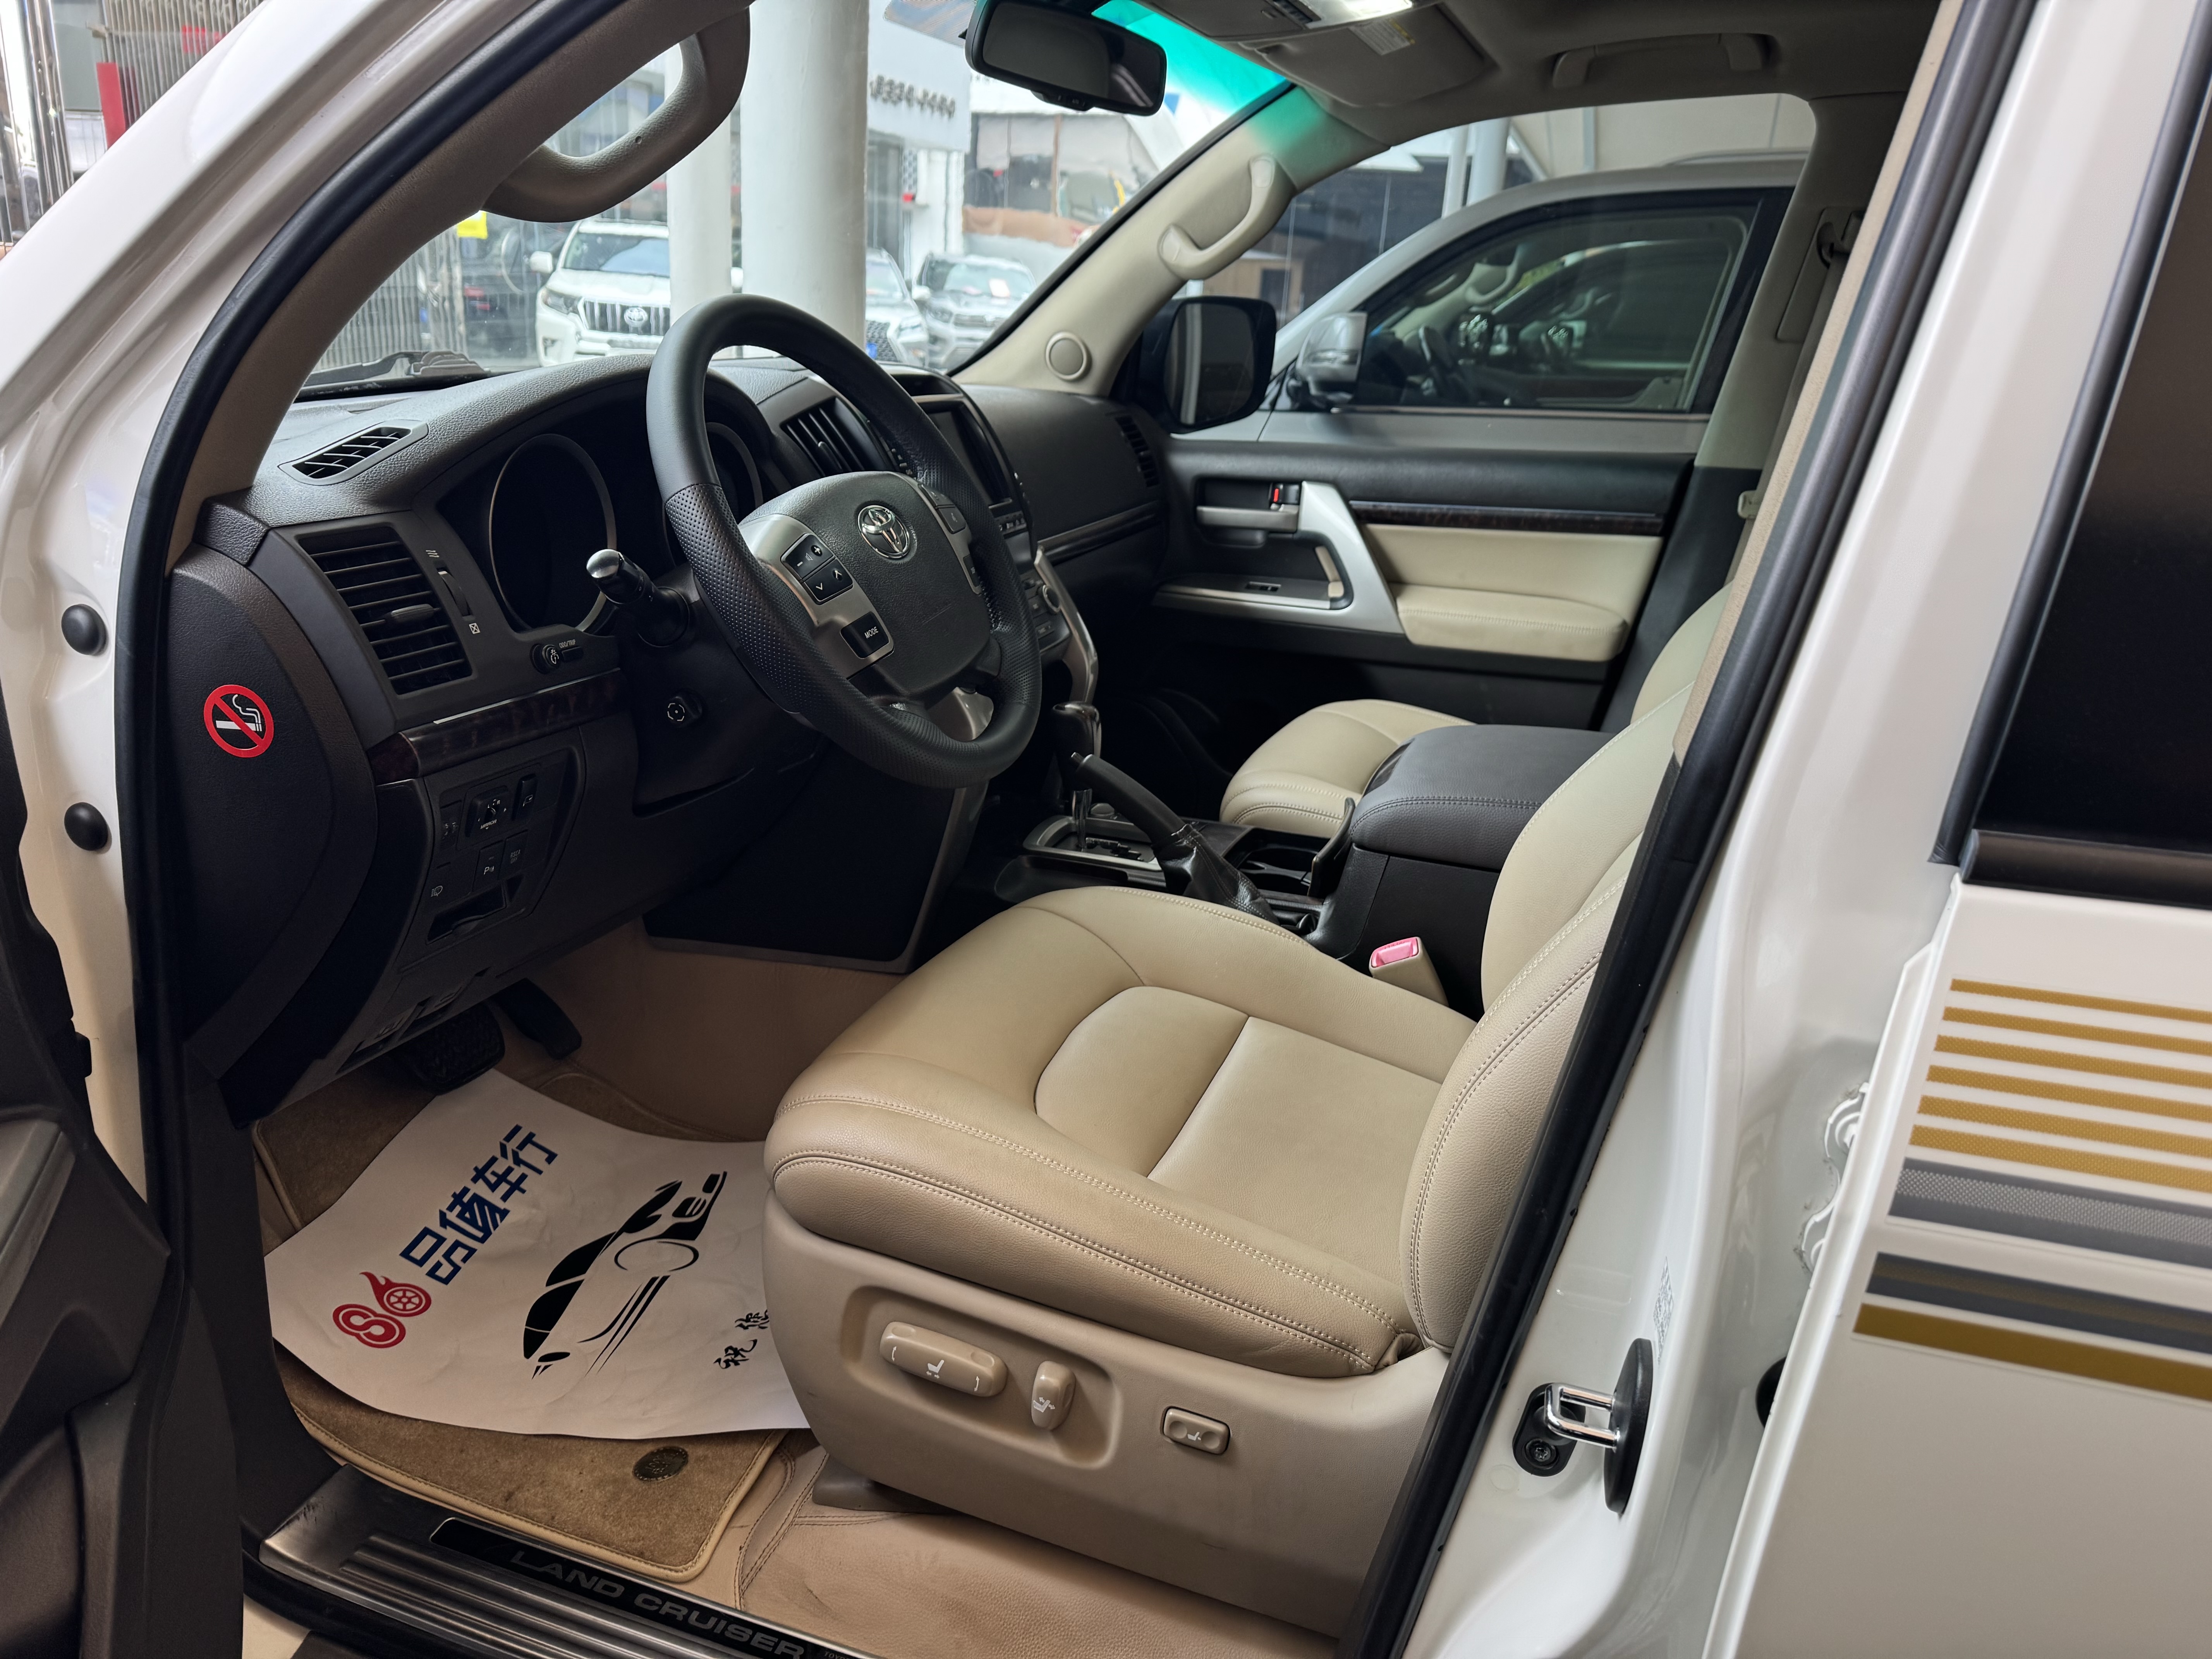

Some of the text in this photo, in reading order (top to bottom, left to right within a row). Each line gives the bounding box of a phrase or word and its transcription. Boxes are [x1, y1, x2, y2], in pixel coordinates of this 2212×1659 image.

[864, 626, 878, 639] MODE
[510, 1550, 805, 1659] LAND CRUISER
